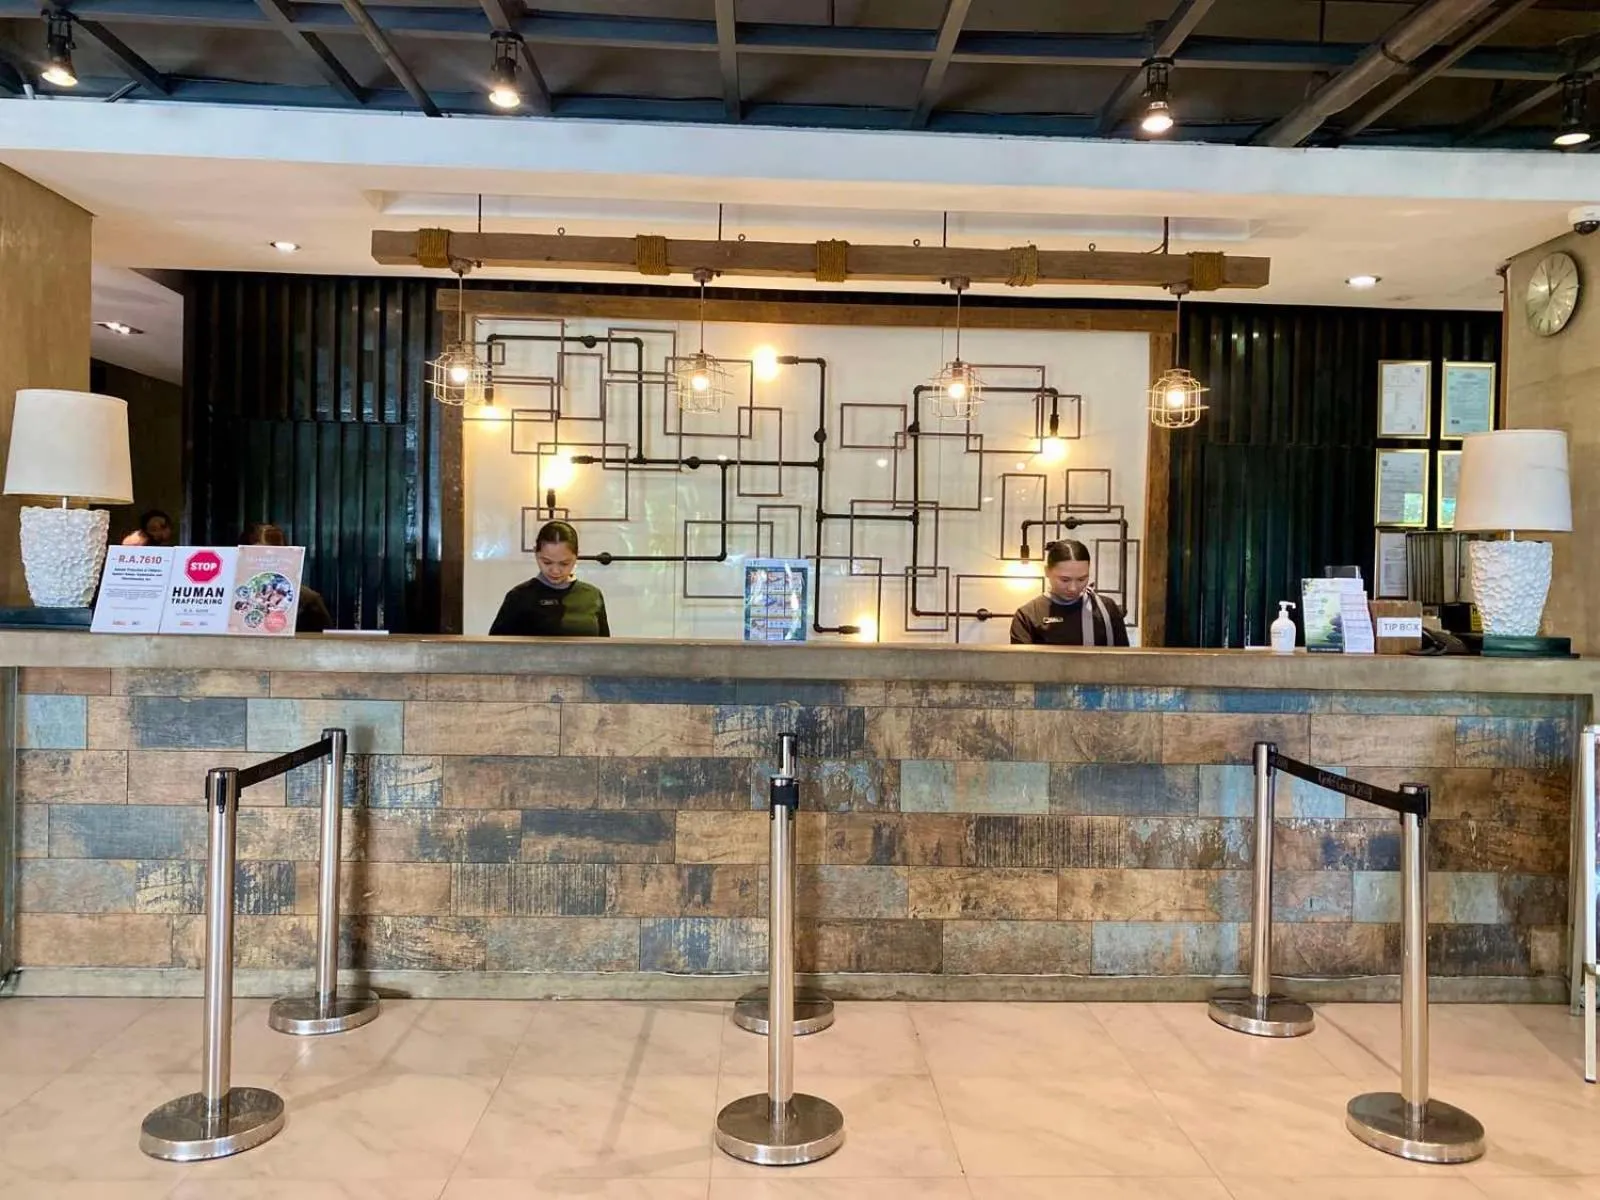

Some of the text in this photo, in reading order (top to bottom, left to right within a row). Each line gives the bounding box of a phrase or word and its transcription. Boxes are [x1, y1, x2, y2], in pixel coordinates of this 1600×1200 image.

[118, 554, 162, 564] R.A.7610
[189, 561, 217, 571] STOP
[172, 586, 224, 598] HUMAN
[1384, 623, 1419, 631] TIP BOX
